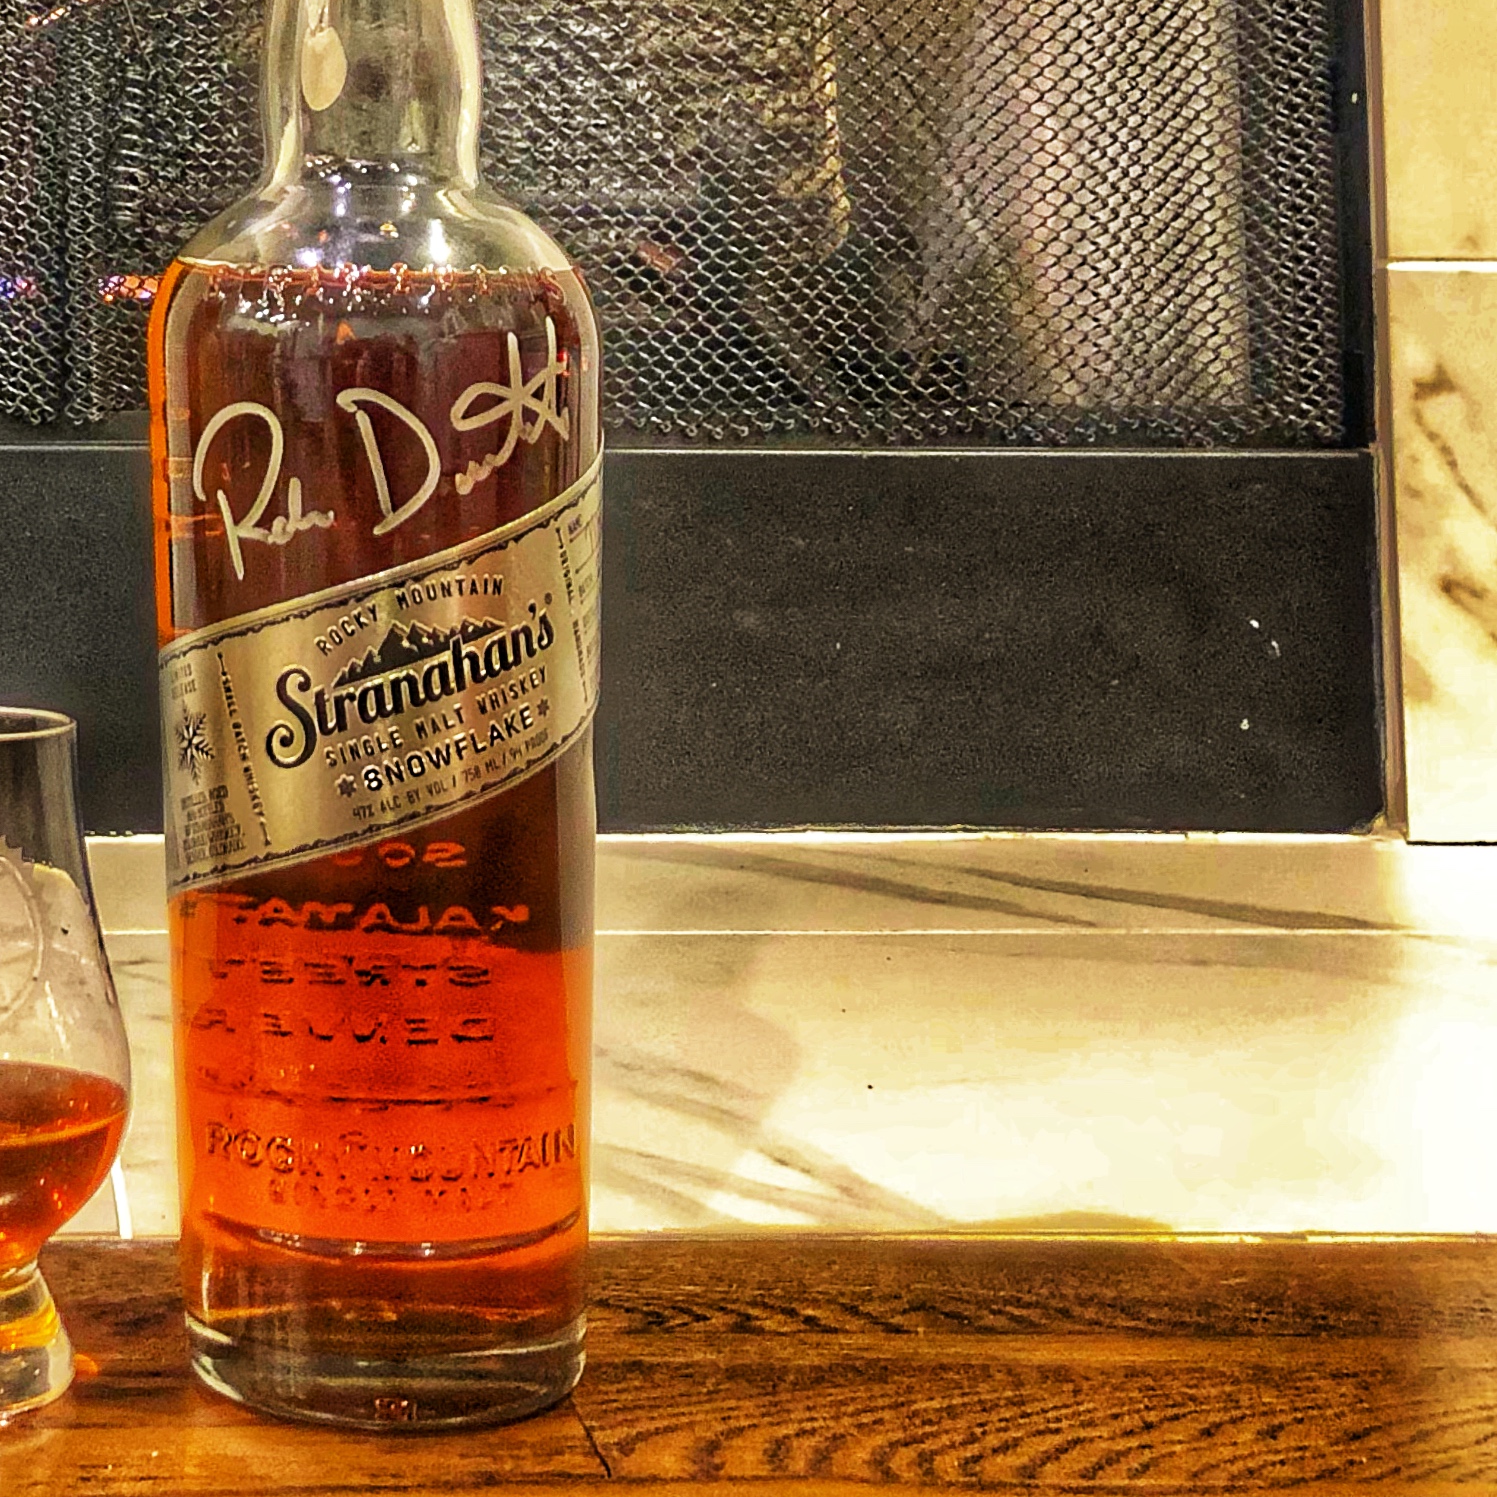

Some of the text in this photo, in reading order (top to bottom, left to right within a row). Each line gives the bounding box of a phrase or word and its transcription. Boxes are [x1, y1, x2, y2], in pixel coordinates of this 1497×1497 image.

[314, 573, 504, 656] ROCKY MOUNTAIN
[324, 664, 548, 768] SINGLE MALT WHISKEY
[362, 702, 535, 793] SNOWFLAKE
[379, 794, 402, 814] ALC
[406, 787, 422, 805] BY
[427, 779, 448, 799] VOL
[484, 756, 500, 774] ML
[206, 1120, 577, 1183] ROC OUNTAIN
